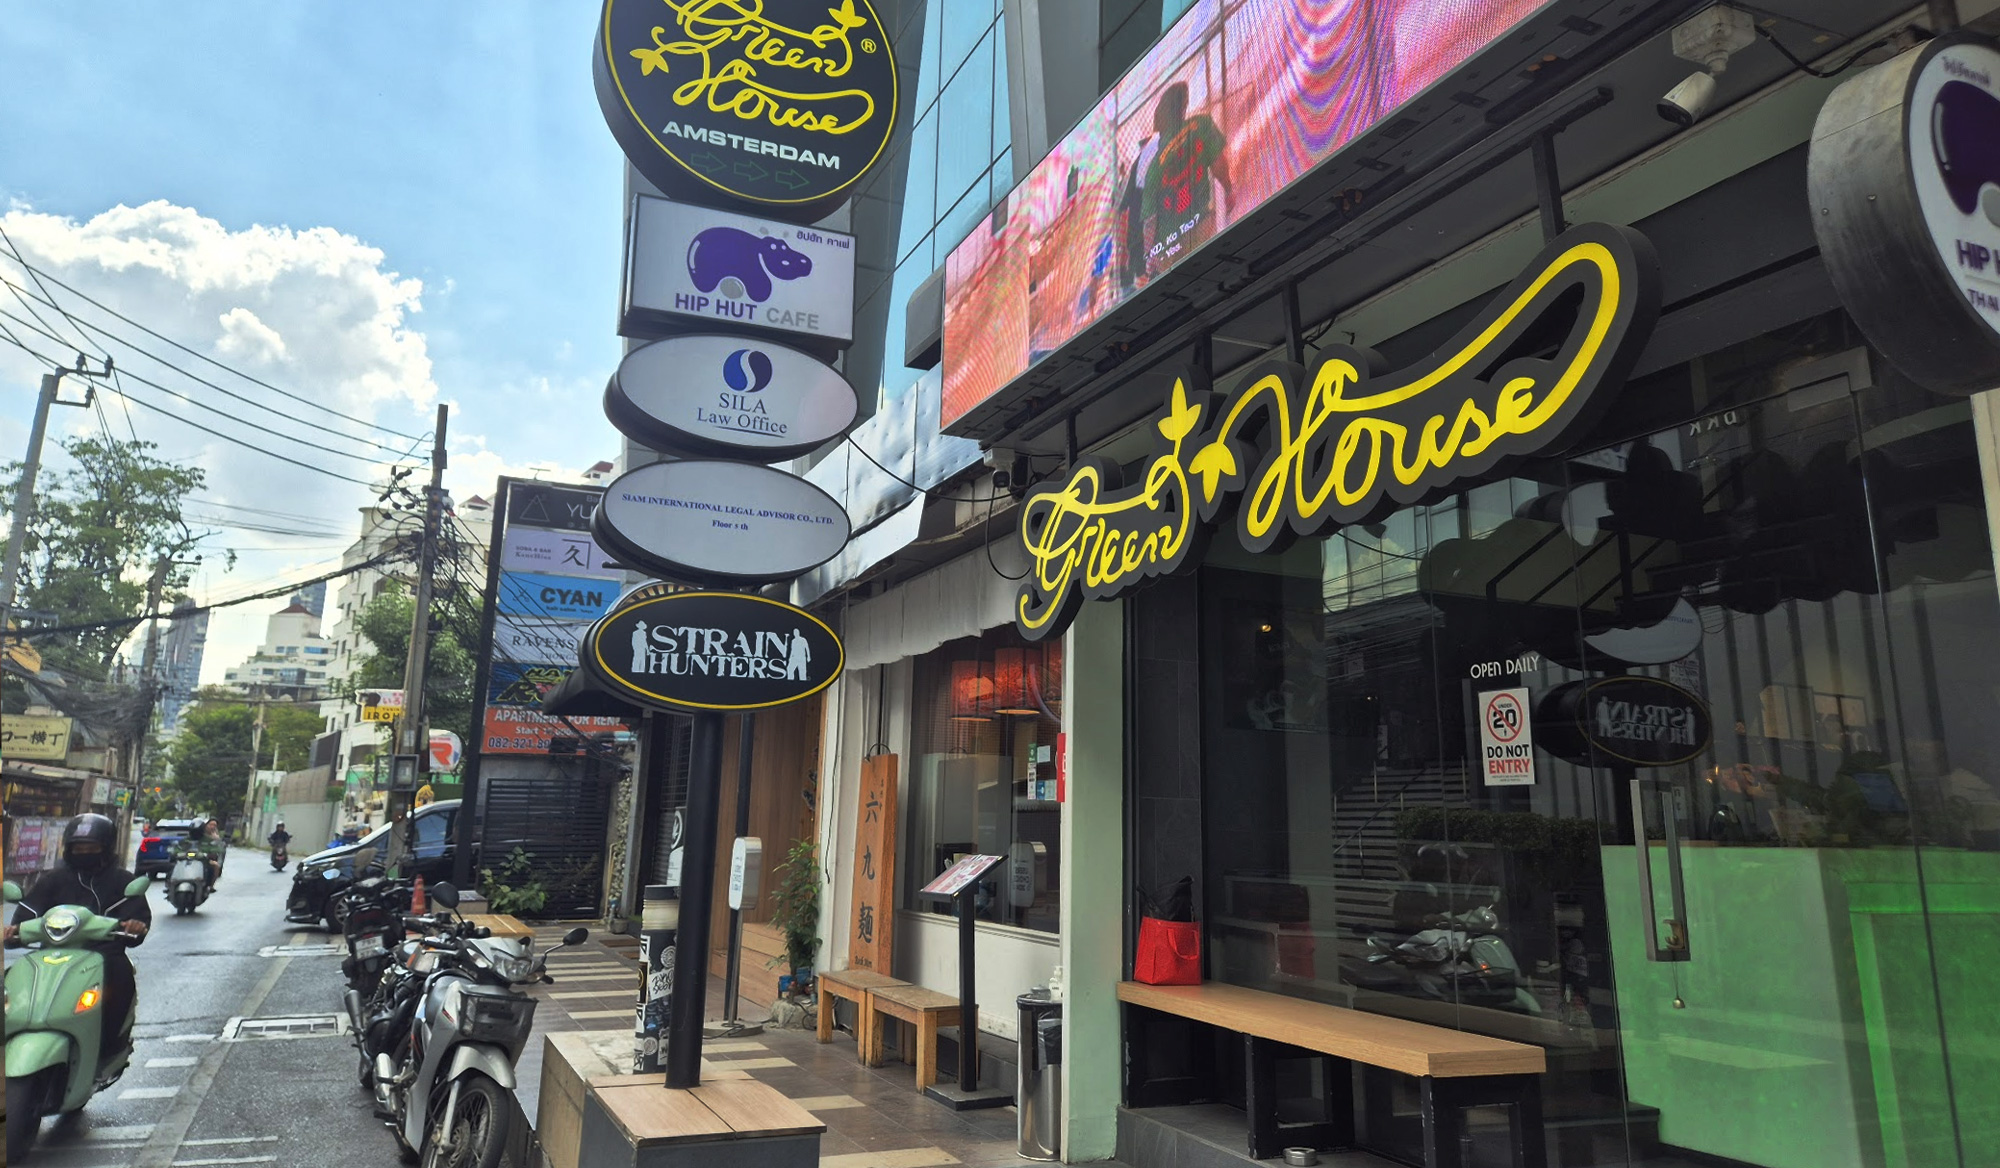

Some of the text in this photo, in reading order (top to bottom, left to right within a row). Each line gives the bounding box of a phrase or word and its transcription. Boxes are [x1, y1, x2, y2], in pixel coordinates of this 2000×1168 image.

[673, 60, 875, 135] House
[662, 121, 841, 170] AMSTERDAM
[1955, 239, 1990, 270] HIP
[675, 292, 819, 330] HIP HUT CAFE
[719, 392, 767, 414] SILA
[1225, 243, 1620, 538] House
[697, 407, 787, 433] Law Office
[621, 493, 646, 504] SIAM
[648, 496, 723, 513] INTERNATIONAL
[725, 505, 755, 516] LEGAL
[757, 510, 795, 521] ADVISOR
[815, 516, 834, 525] LTD.
[712, 519, 732, 529] Floor
[740, 523, 748, 531] th
[1020, 456, 1192, 629] Green
[541, 586, 603, 607] CYAN
[650, 625, 789, 659] STRAIN
[648, 652, 787, 680] HUNTERS
[1470, 655, 1540, 679] OPEN DAILY
[515, 726, 538, 735] Start
[1493, 709, 1517, 729] 20
[1487, 744, 1529, 758] DO NOT
[1488, 759, 1530, 774] ENTRY
